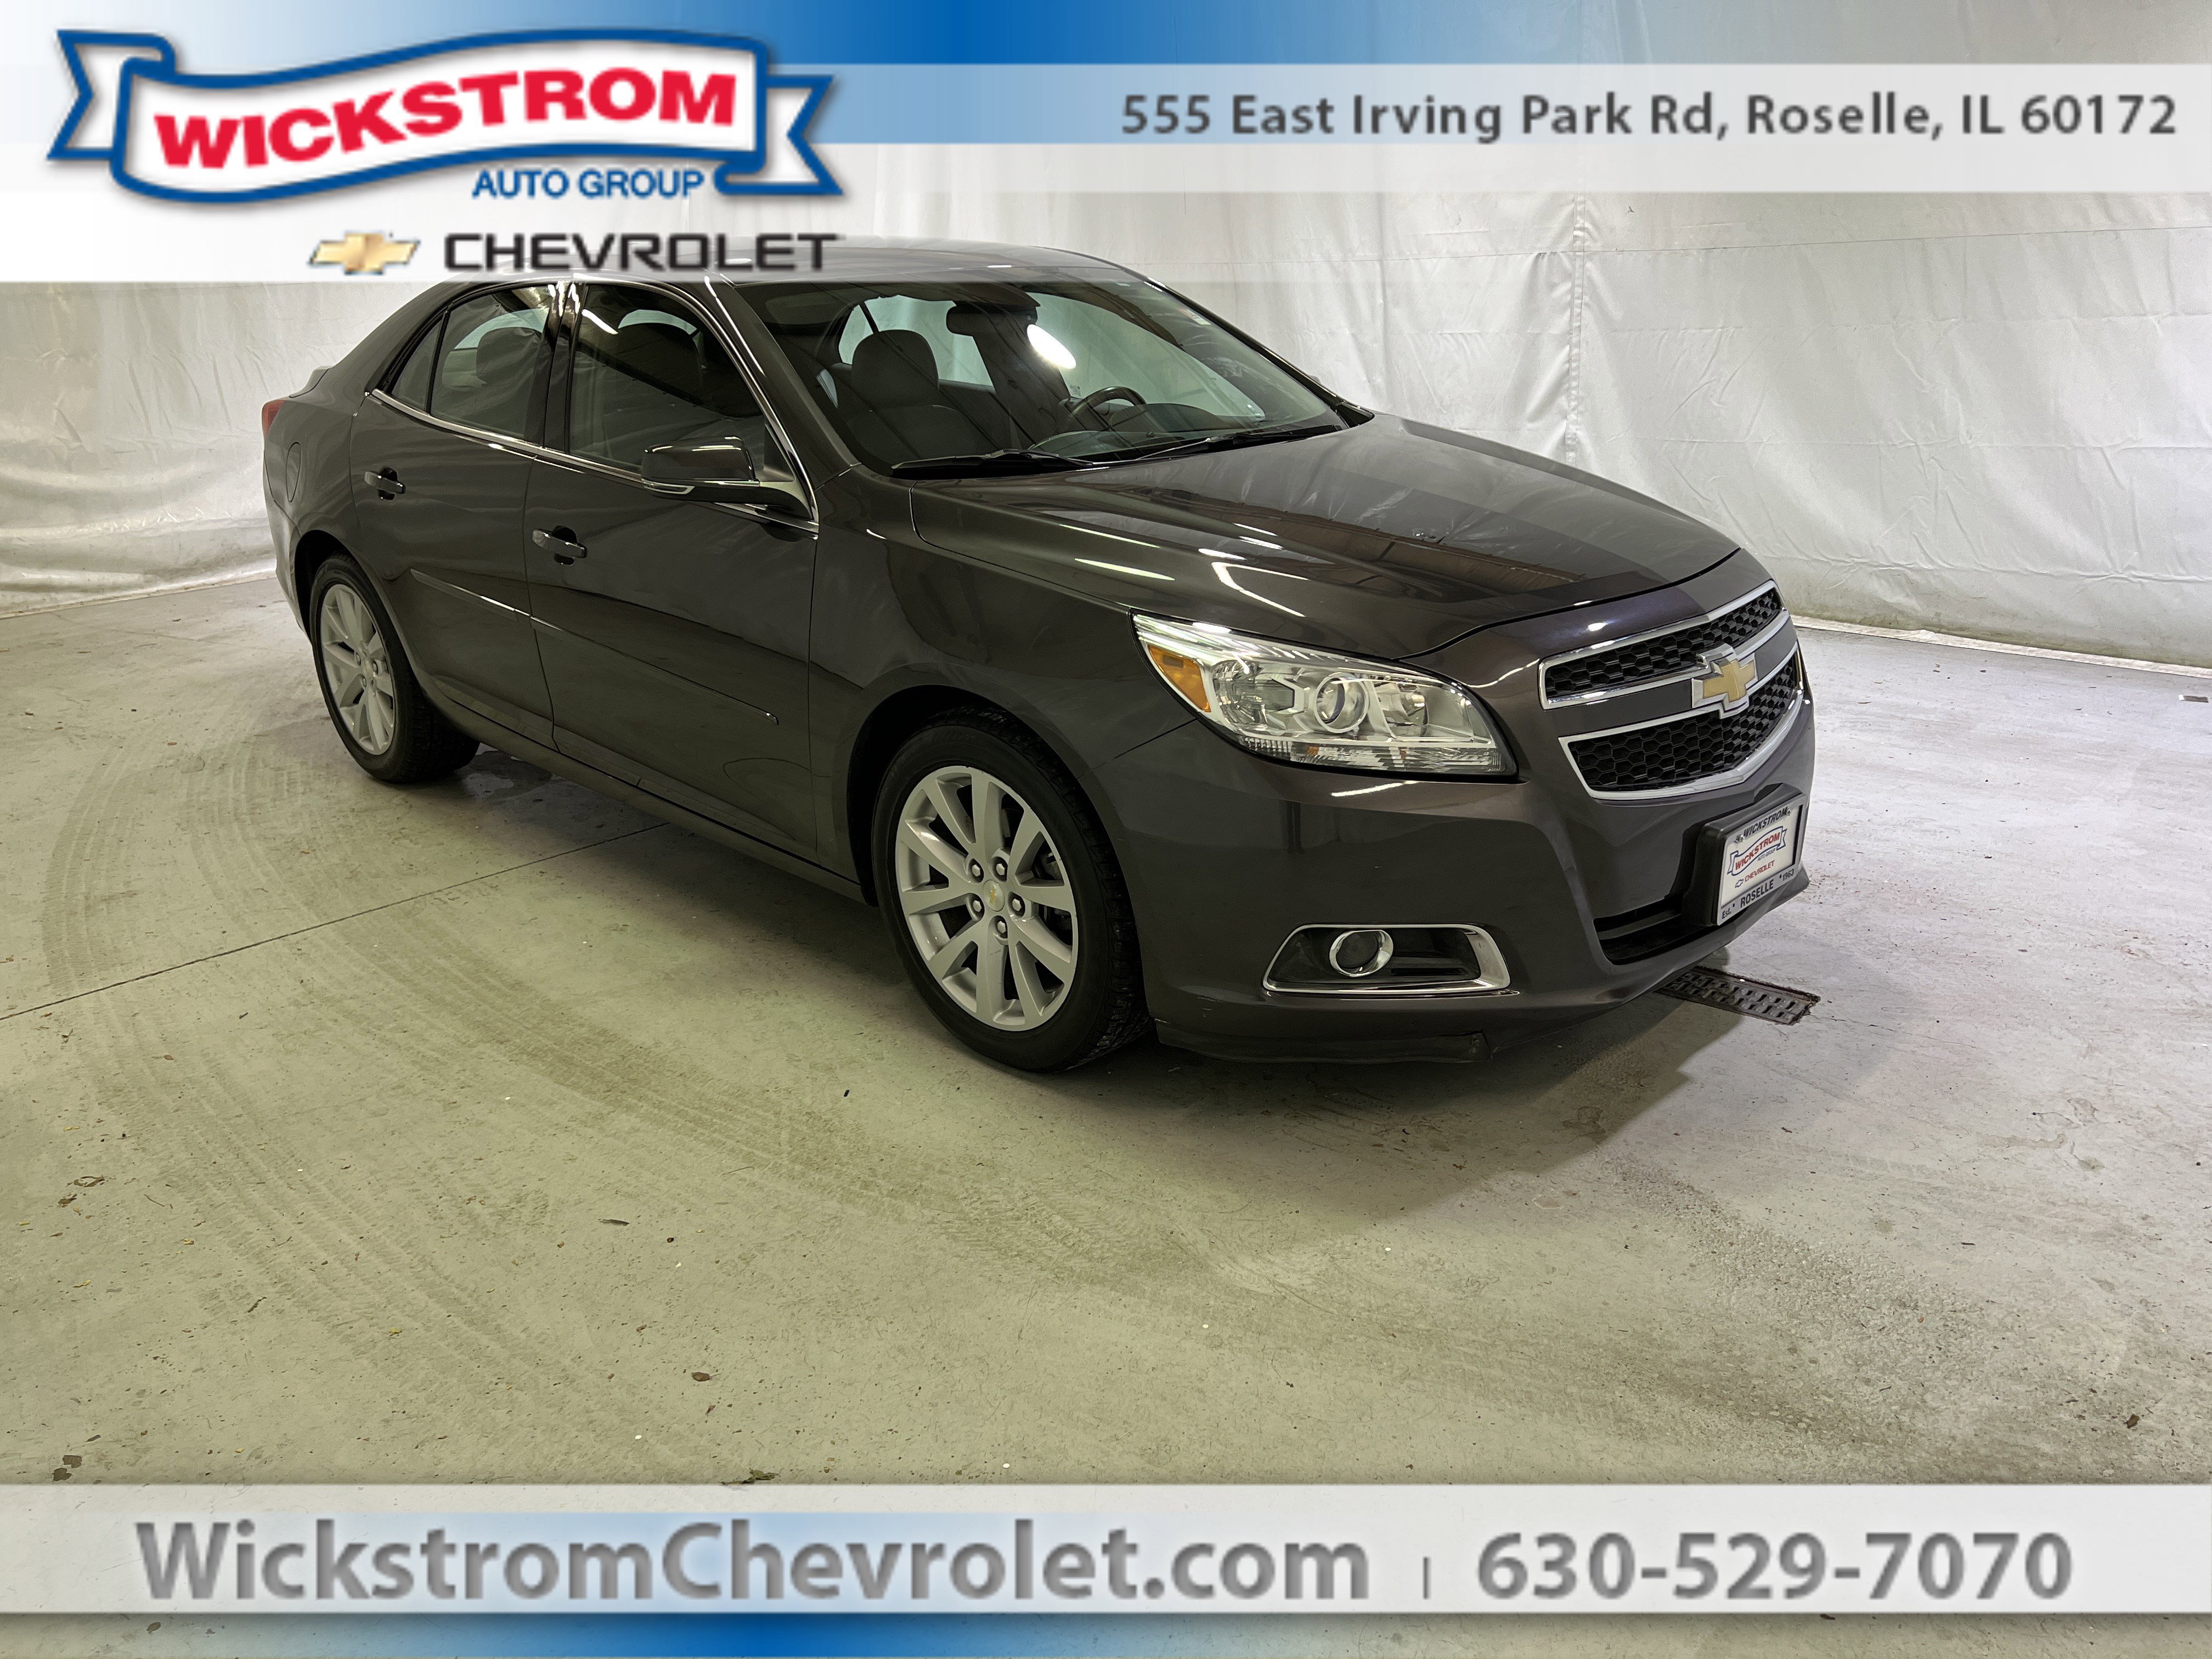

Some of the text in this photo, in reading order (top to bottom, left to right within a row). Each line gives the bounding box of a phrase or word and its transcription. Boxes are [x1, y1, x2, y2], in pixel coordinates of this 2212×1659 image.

[1743, 806, 1788, 837] WICKSTROM
[1735, 832, 1781, 871] WICKSTROM
[1740, 879, 1774, 908] ROSELLE
[1782, 868, 1795, 881] 1963
[1745, 860, 1775, 882] CHEVROLET
